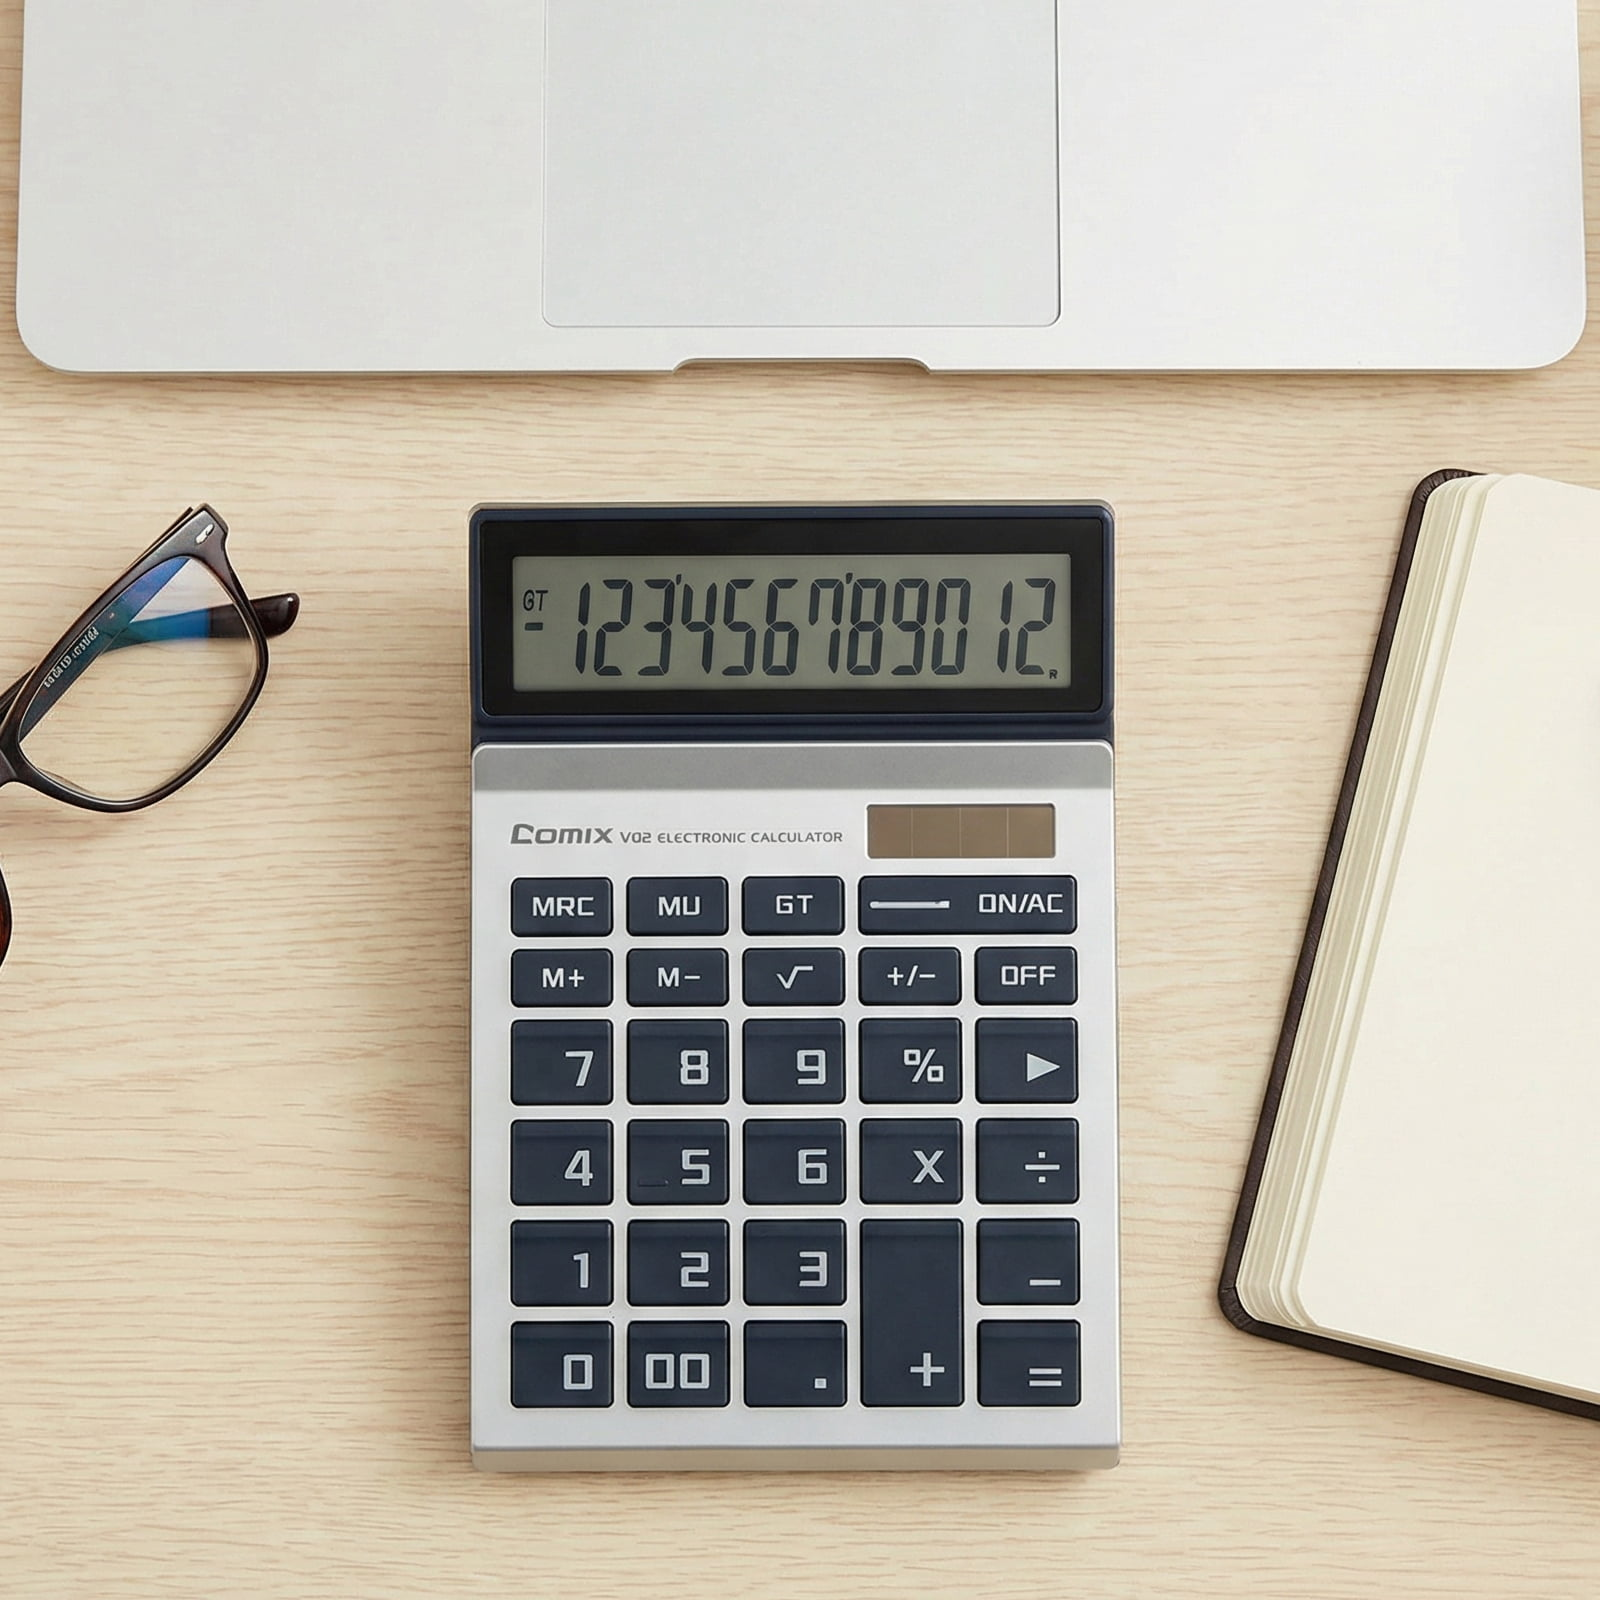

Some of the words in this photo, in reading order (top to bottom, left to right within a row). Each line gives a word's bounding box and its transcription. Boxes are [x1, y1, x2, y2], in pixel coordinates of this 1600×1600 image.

[522, 588, 549, 612] GT
[510, 823, 613, 845] Comix
[657, 832, 746, 844] ELECTRONIC
[750, 831, 843, 843] CALCULATOR
[533, 896, 595, 917] MRC
[658, 895, 700, 916] MU
[775, 895, 814, 914] GT
[978, 893, 1064, 914] ON/AC
[542, 968, 585, 988] M+
[657, 968, 701, 988] M-
[1001, 965, 1056, 986] OFF
[565, 1050, 594, 1087] 7
[680, 1049, 709, 1085] 8
[797, 1049, 827, 1085] 9
[903, 1048, 944, 1083] %
[564, 1149, 594, 1187] 4
[681, 1149, 710, 1185] 5
[798, 1148, 828, 1185] 6
[573, 1252, 589, 1289] 1
[680, 1251, 710, 1288] 2
[799, 1251, 828, 1287] 3
[563, 1354, 593, 1390] 0
[645, 1353, 710, 1389] 00
[910, 1352, 945, 1387] +
[1029, 1367, 1062, 1387] =
